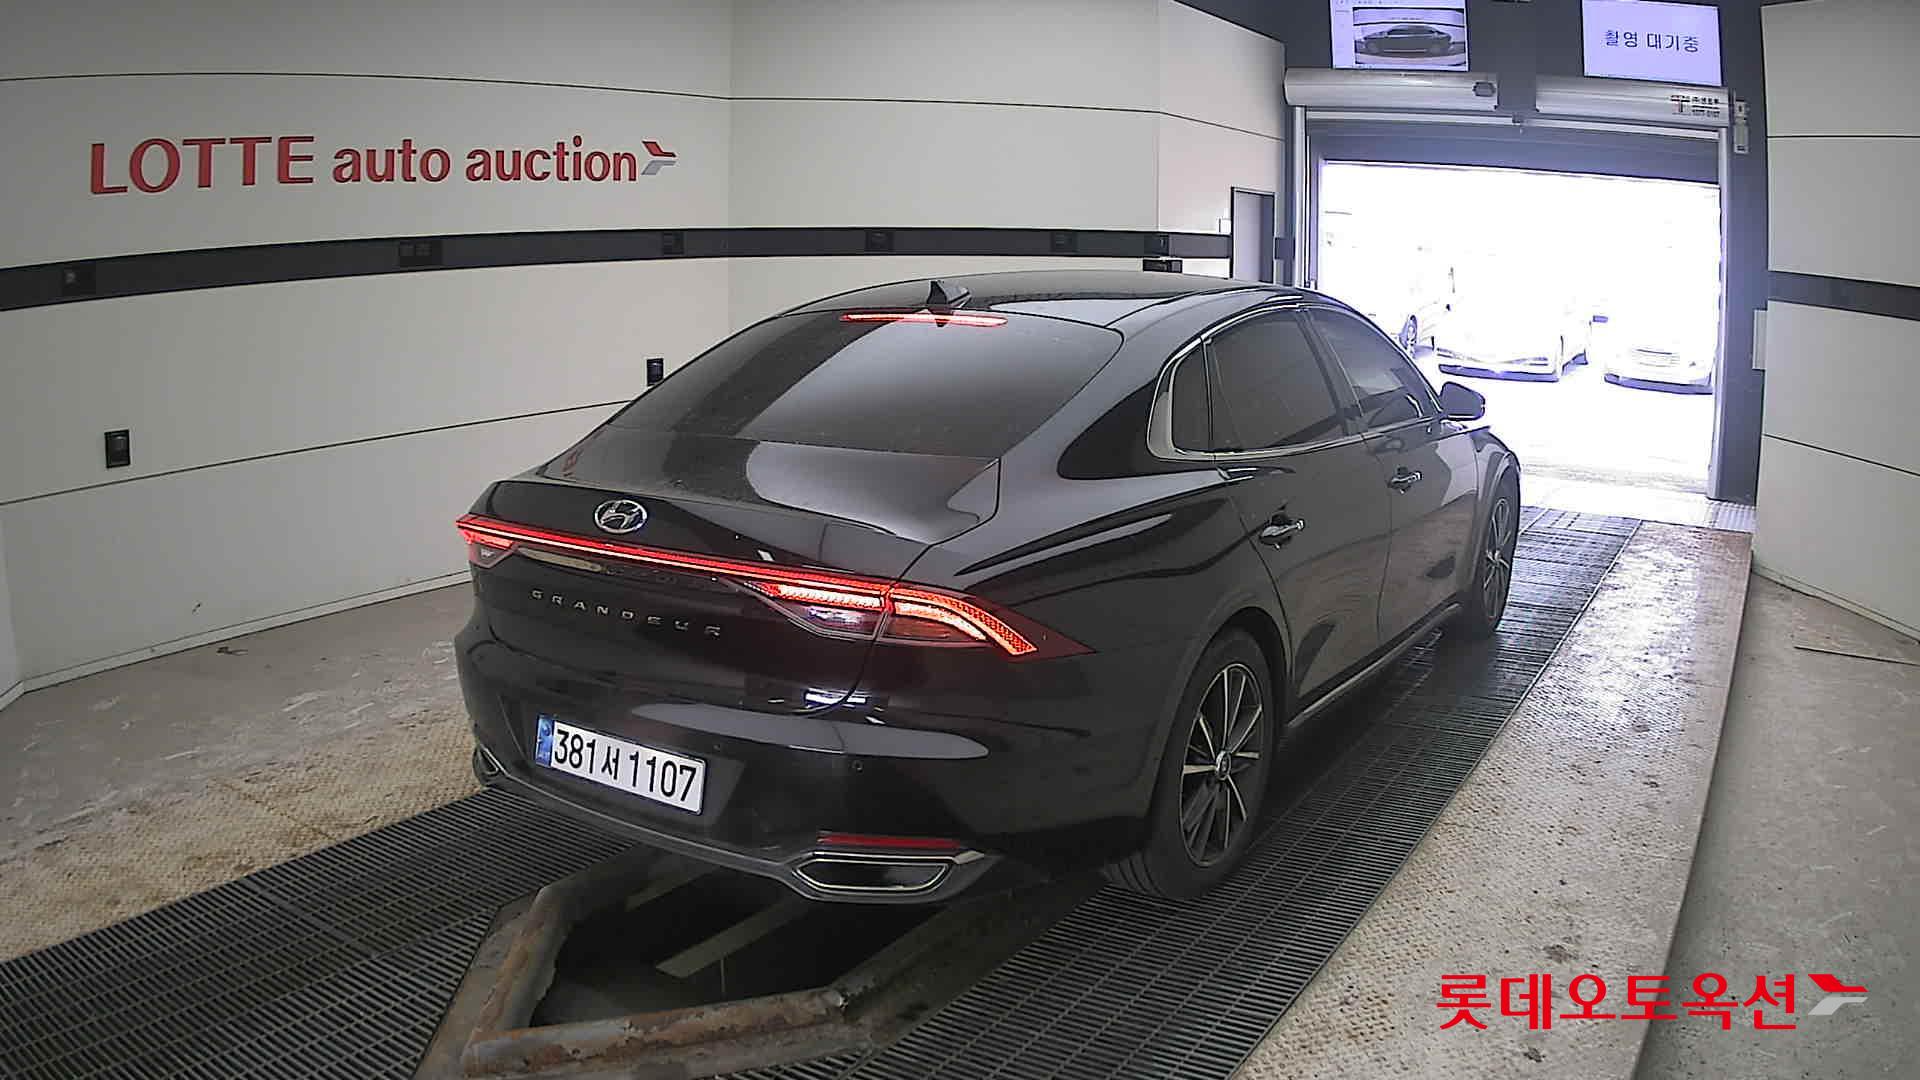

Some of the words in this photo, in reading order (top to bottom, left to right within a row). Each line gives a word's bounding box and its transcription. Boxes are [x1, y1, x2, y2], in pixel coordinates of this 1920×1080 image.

[1605, 30, 1638, 48] 촬영
[1646, 33, 1698, 52] 대기중
[90, 135, 315, 195] LOTTE
[332, 138, 451, 183] auto
[464, 135, 638, 183] auction
[531, 588, 722, 637] GRANDEUR
[629, 750, 697, 803] 1107
